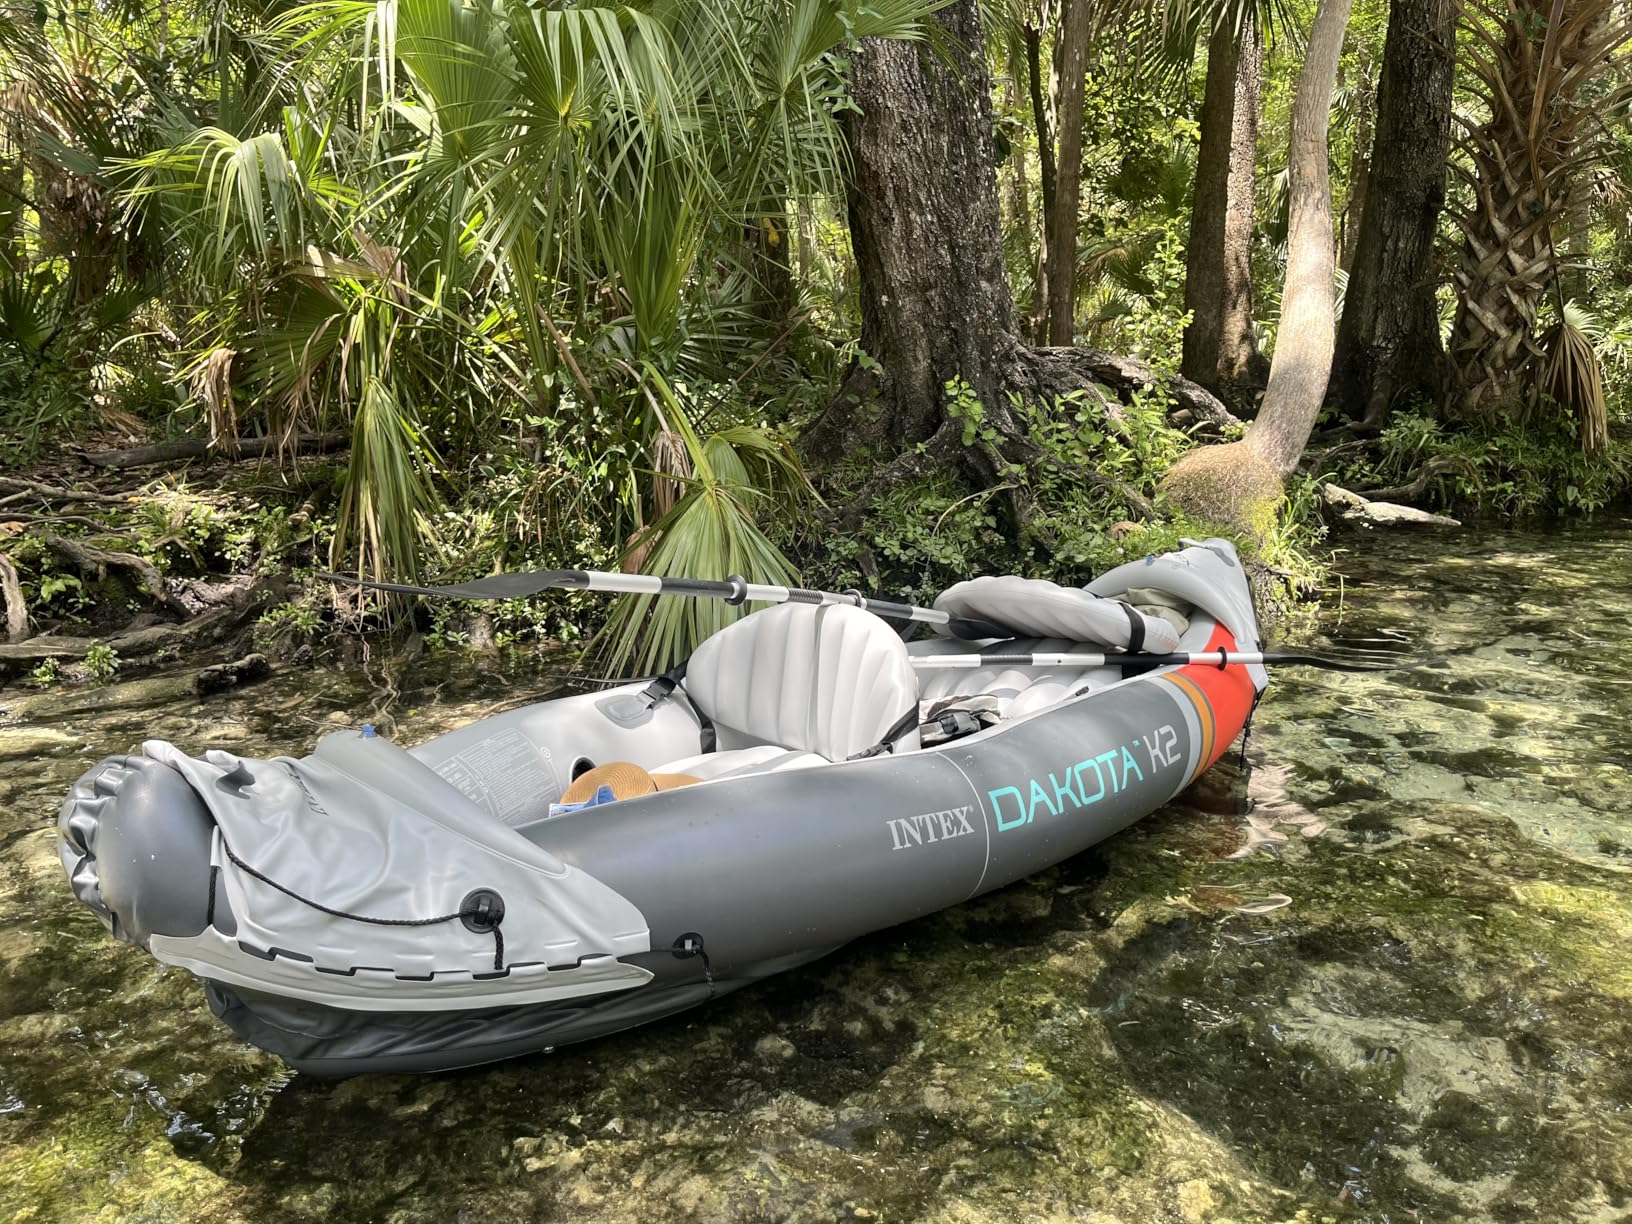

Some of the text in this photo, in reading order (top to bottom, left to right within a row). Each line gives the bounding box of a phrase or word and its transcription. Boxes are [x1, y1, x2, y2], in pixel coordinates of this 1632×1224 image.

[988, 724, 1182, 832] DAKOTA K2
[886, 806, 975, 850] INTEX
